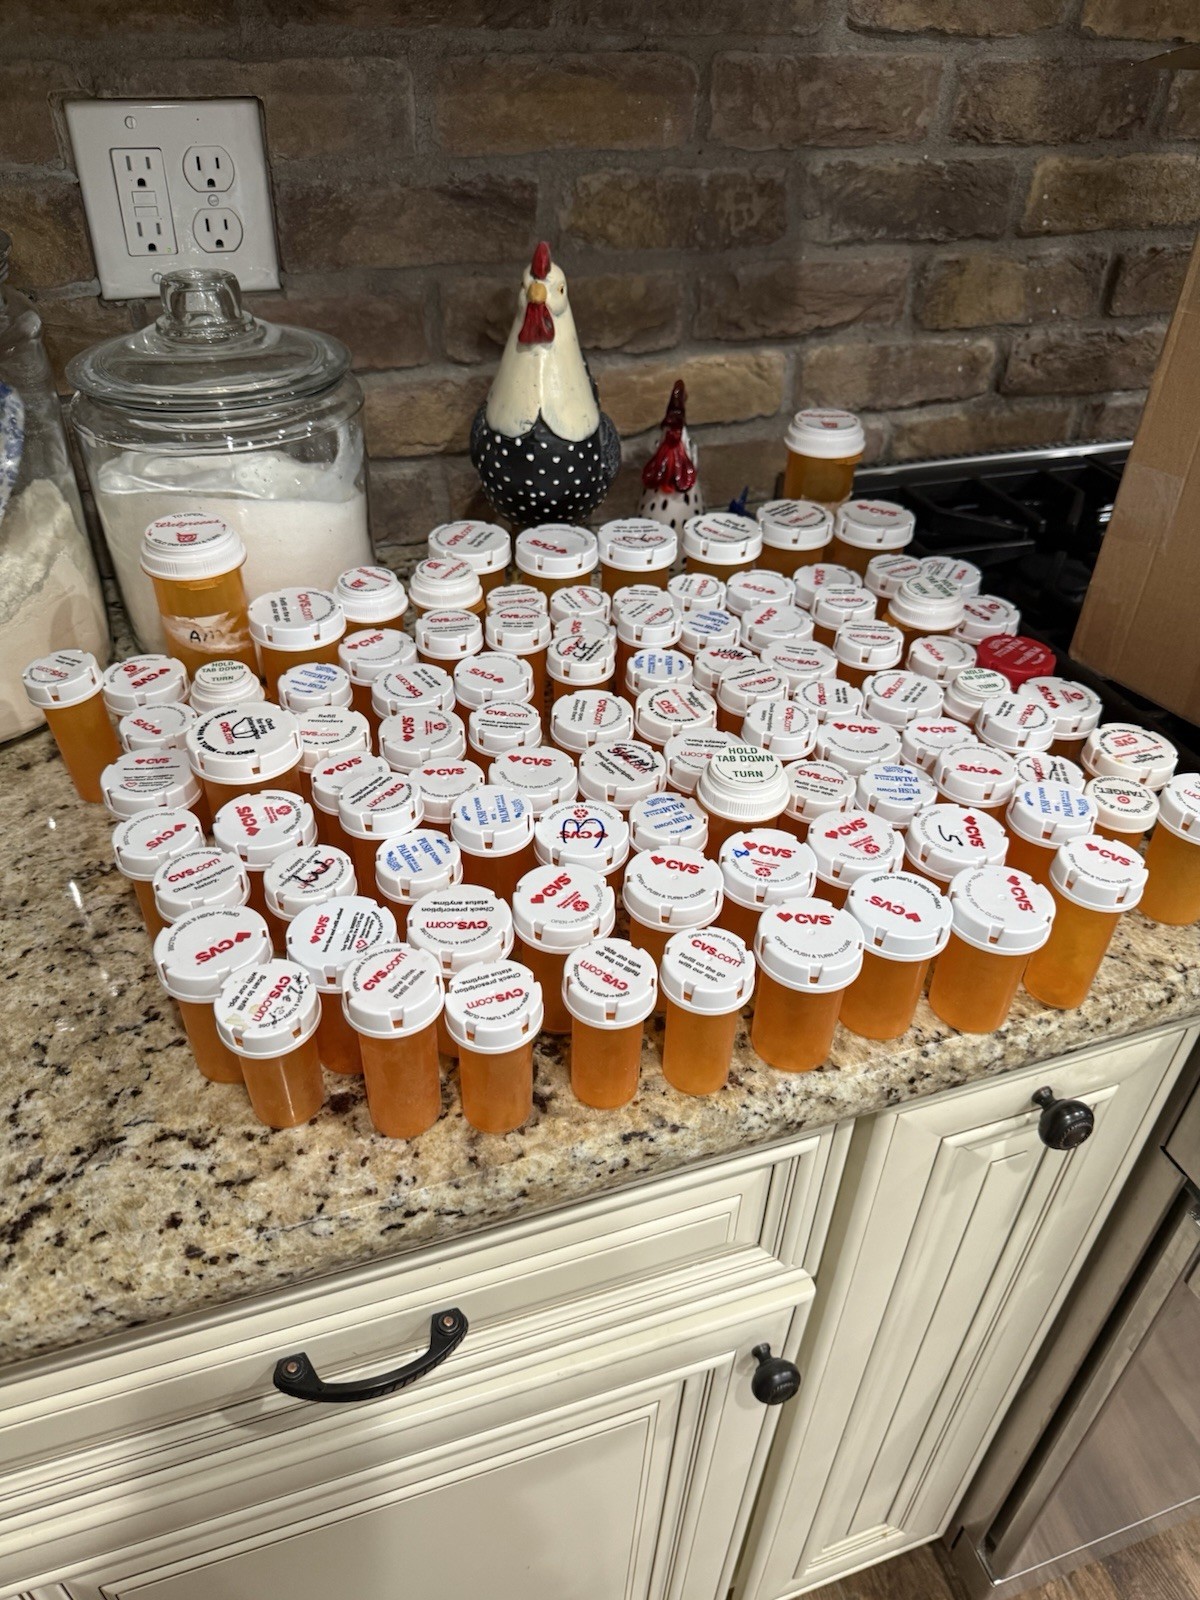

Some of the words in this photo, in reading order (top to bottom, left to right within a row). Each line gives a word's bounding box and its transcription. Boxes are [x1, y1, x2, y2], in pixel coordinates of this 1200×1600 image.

[155, 520, 221, 528] Walgreens
[529, 538, 556, 551] CVS
[741, 582, 765, 592] CVS
[499, 612, 537, 620] CVS.com
[358, 633, 384, 648] CVS
[131, 672, 160, 688] CVS
[469, 667, 495, 681] CVS
[396, 674, 422, 698] CVS.com
[882, 678, 904, 699] CVS.com
[485, 708, 525, 718] CVS.com
[594, 699, 607, 724] CVS.com
[659, 699, 678, 714] CVS
[132, 718, 155, 732] CVS
[402, 716, 414, 736] CVS
[784, 707, 794, 730] CVS.com
[846, 723, 879, 734] CVS
[930, 725, 956, 733] CVS
[1114, 736, 1137, 747] CVS
[146, 756, 171, 765] CVS
[334, 756, 361, 773] CVS
[521, 756, 552, 767] CVS
[435, 767, 464, 775] CVS
[609, 763, 635, 782] prescription
[732, 770, 764, 778] TURN
[797, 768, 842, 783] CVS.com
[957, 763, 988, 774] CVS
[369, 782, 405, 807] CVS.com
[1100, 787, 1145, 797] TARGET
[660, 803, 685, 814] PALM
[235, 805, 258, 829] CVS
[479, 808, 489, 826] PUSH
[654, 819, 673, 829] DOWN
[673, 813, 695, 825] PUSH
[560, 830, 594, 839] CVS
[837, 818, 868, 837] CVS
[145, 830, 175, 849] CVS
[965, 825, 984, 847] CVS
[417, 837, 432, 854] PUSH
[429, 851, 443, 866] DOWN
[757, 844, 792, 858] CVS
[1098, 849, 1130, 866] CVS
[167, 857, 220, 883] CVS.com
[665, 859, 700, 874] CVS
[173, 882, 195, 893] Check
[198, 865, 235, 884] prescription
[786, 872, 801, 881] CLOSE
[871, 875, 890, 883] CLOSE
[194, 878, 219, 891] history.
[541, 875, 573, 898] CVS
[636, 873, 644, 885] OPEN
[647, 888, 661, 897] PUSH
[689, 888, 706, 898] CLOSE
[870, 895, 906, 916] CVS
[1010, 886, 1033, 910] CVS
[313, 915, 329, 936] CVS
[426, 919, 489, 930] CVS.com
[794, 913, 831, 925] CVS
[195, 938, 235, 963] CVS
[691, 938, 743, 965] CVS.com
[774, 936, 787, 948] OPEN
[793, 949, 810, 958] PUSH
[838, 940, 852, 953] CLOSE
[603, 954, 614, 964] the
[628, 959, 641, 969] with
[679, 952, 695, 963] Refill
[705, 964, 716, 973] the
[716, 971, 726, 979] go
[362, 952, 405, 991] CVS.com
[489, 968, 513, 978] status
[499, 972, 521, 984] Check
[579, 961, 628, 991] CVS.com
[623, 966, 640, 977] Refill
[678, 959, 692, 969] with
[693, 967, 703, 975] our
[704, 973, 718, 983] app.
[459, 973, 487, 985] anytime.
[388, 981, 401, 993] Save
[394, 985, 408, 999] Refill
[454, 980, 498, 994] prescription
[253, 975, 292, 1021] CVS.com
[467, 987, 525, 1008] CVS.com
